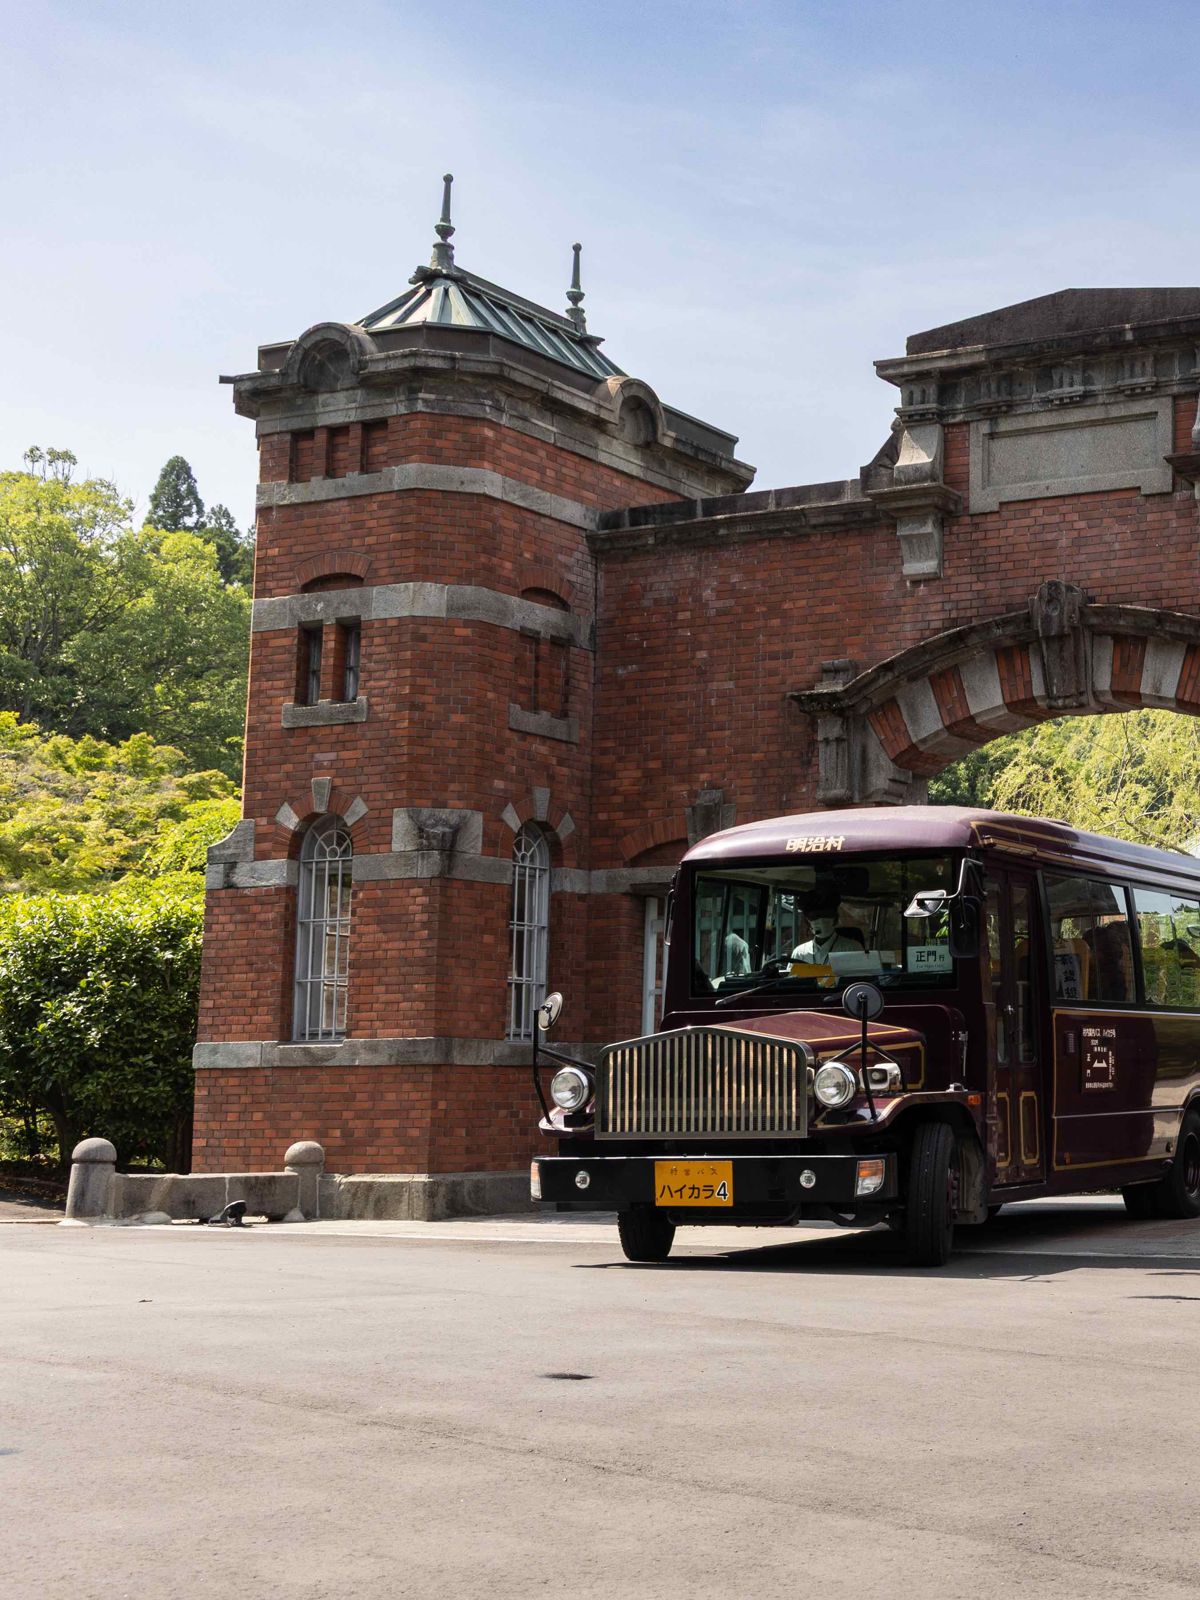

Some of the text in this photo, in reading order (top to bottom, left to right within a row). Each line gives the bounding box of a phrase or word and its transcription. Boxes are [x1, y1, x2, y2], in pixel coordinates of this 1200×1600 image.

[785, 835, 846, 853] 明治村
[915, 950, 945, 962] 正門行
[660, 1180, 729, 1201] ハイカラ4
